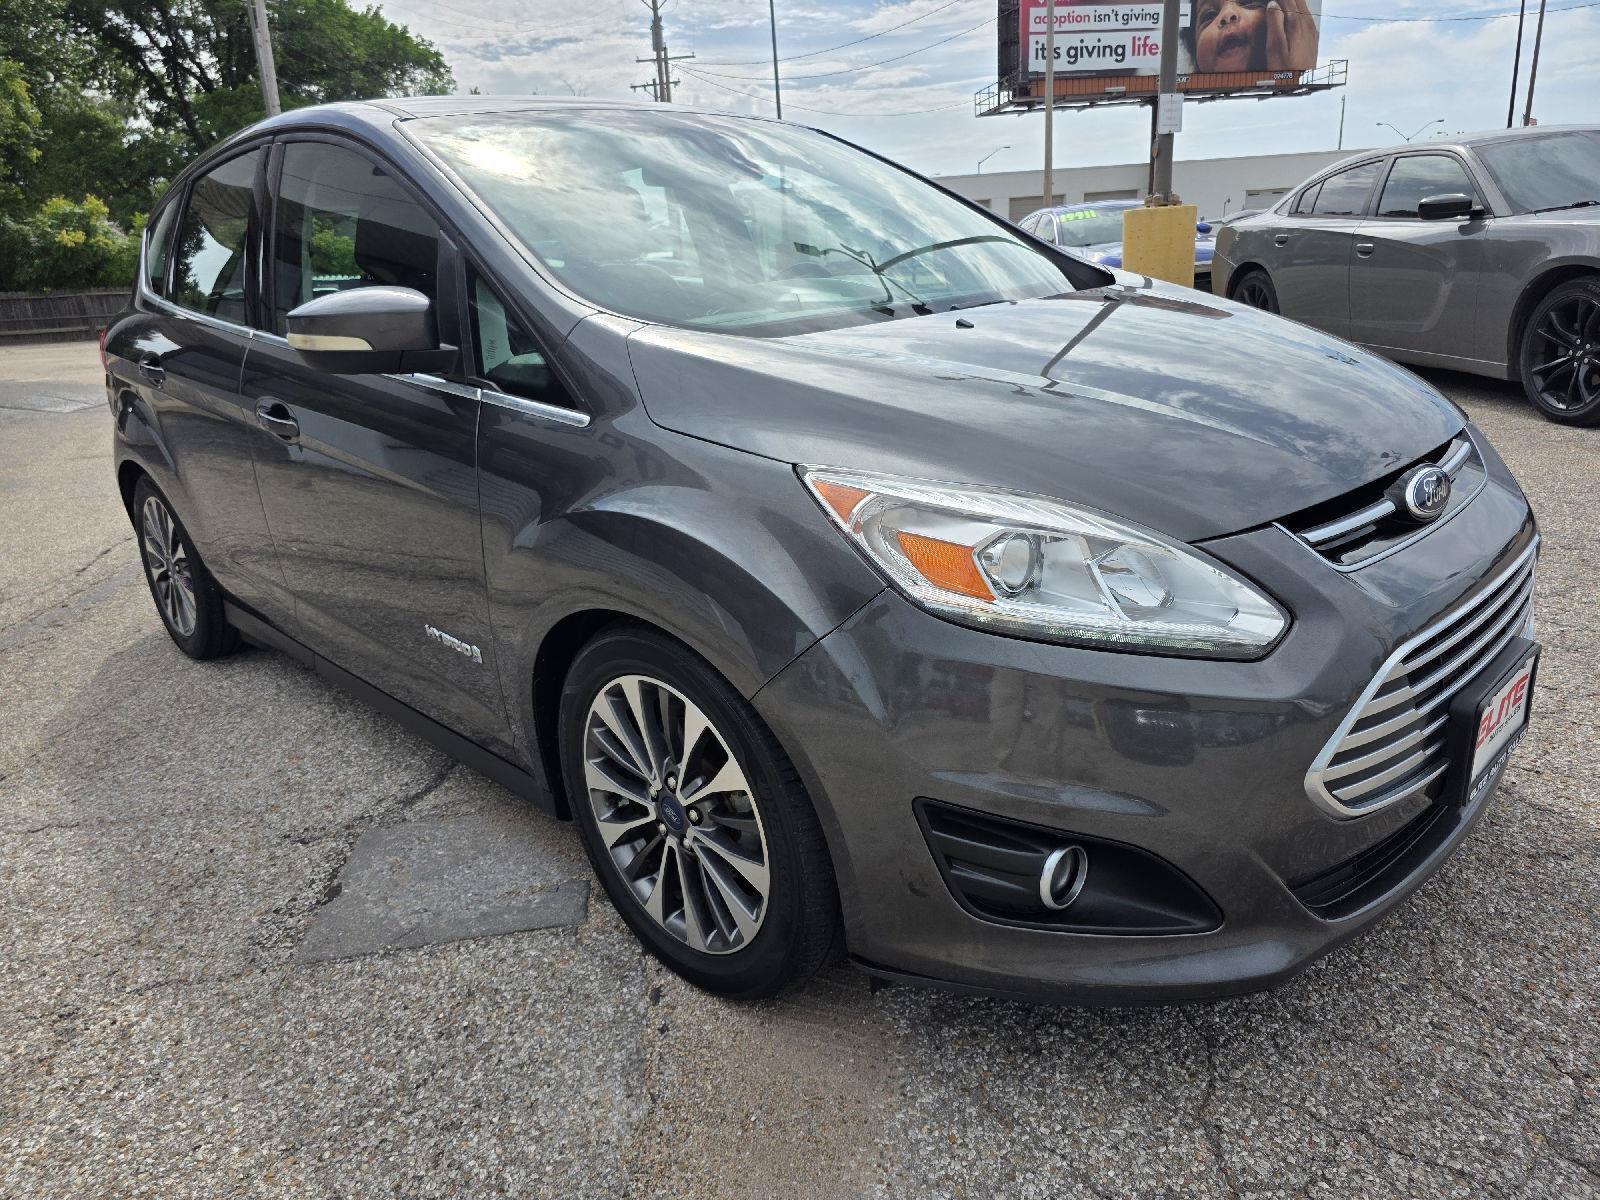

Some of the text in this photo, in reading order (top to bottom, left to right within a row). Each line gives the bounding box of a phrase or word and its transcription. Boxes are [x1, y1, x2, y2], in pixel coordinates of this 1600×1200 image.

[1094, 8, 1119, 23] isn't
[1122, 8, 1159, 25] giving
[1035, 40, 1061, 60] its
[1066, 38, 1126, 65] giving
[1423, 475, 1447, 507] Ford
[1475, 672, 1530, 751] ELITE
